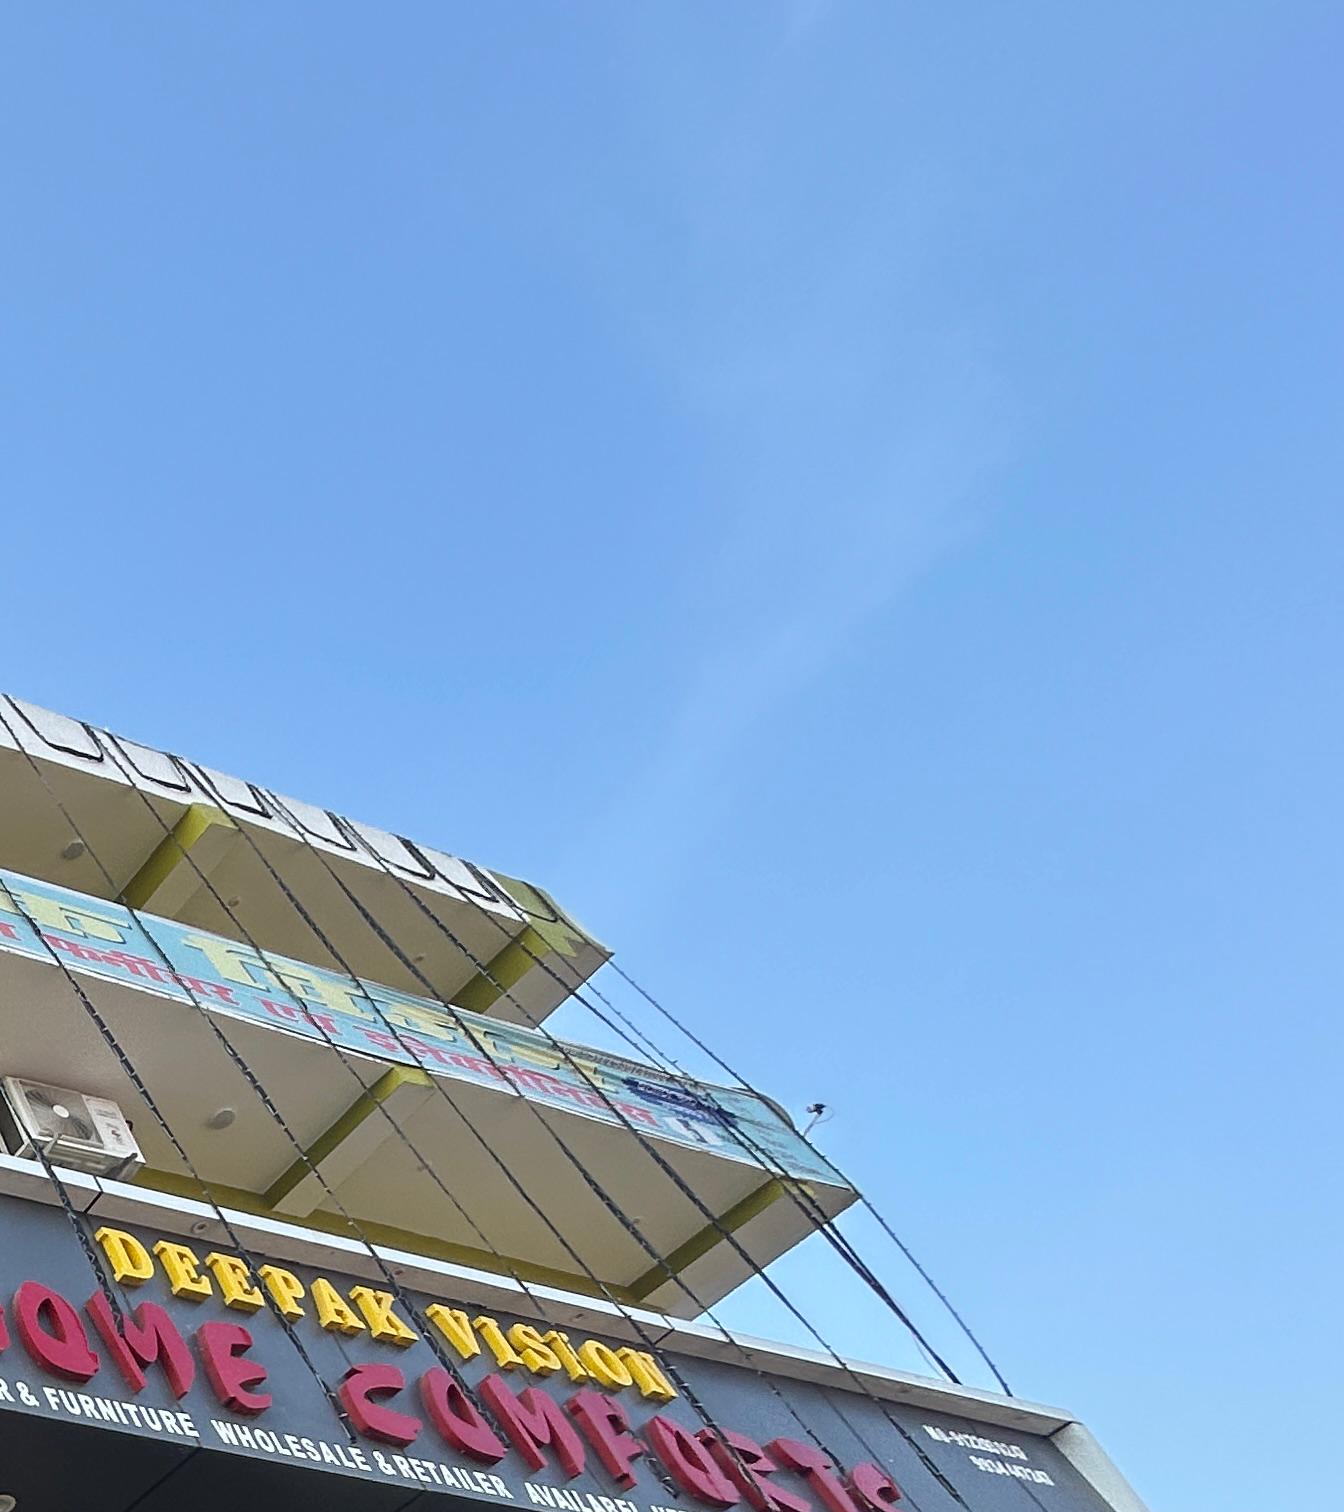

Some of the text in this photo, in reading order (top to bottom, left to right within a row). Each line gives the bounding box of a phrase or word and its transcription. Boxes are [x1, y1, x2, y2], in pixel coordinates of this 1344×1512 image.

[94, 1226, 679, 1402] DEEPAK VISION
[18, 1381, 40, 1408] &
[43, 1386, 200, 1439] FURNITURE
[211, 1419, 374, 1474] WHOLESALE
[378, 1449, 402, 1477] &
[401, 1453, 514, 1500] RETAILER
